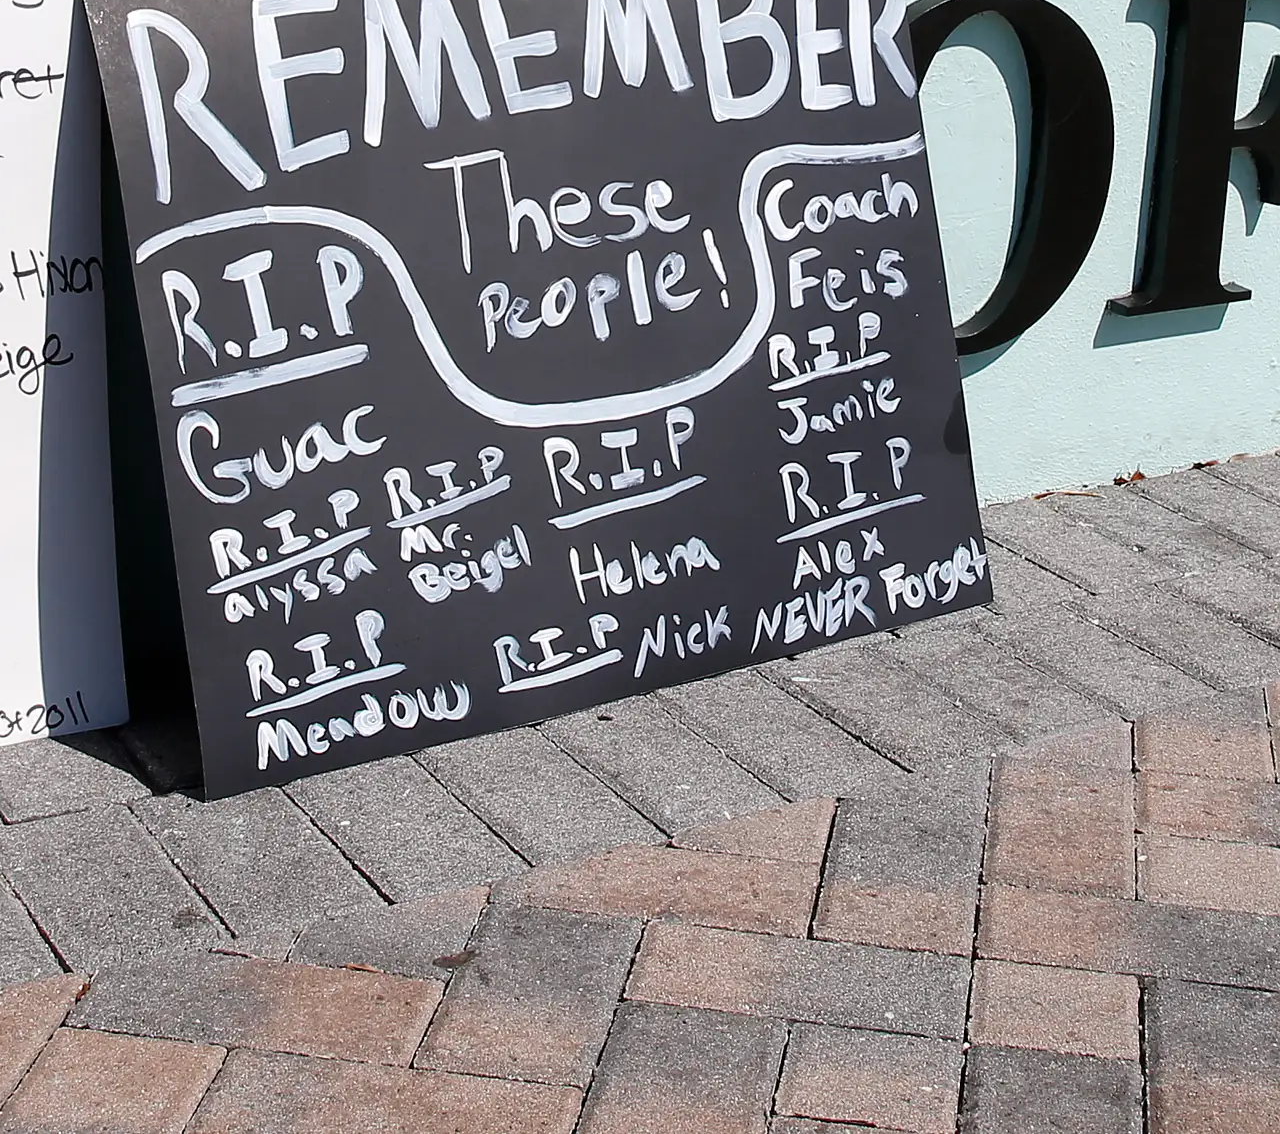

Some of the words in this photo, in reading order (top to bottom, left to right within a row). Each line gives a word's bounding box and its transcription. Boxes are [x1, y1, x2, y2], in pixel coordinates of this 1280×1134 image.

[424, 150, 690, 273] These
[765, 173, 918, 241] Coach
[789, 248, 907, 311] Feis
[778, 379, 901, 443] Jamie
[177, 406, 386, 503] Guac
[408, 524, 531, 602] Beigel
[570, 537, 720, 603] Helena
[794, 528, 884, 589] Alex
[751, 576, 877, 653] NEVER
[879, 537, 987, 614] Forget
[635, 606, 731, 677] Nick
